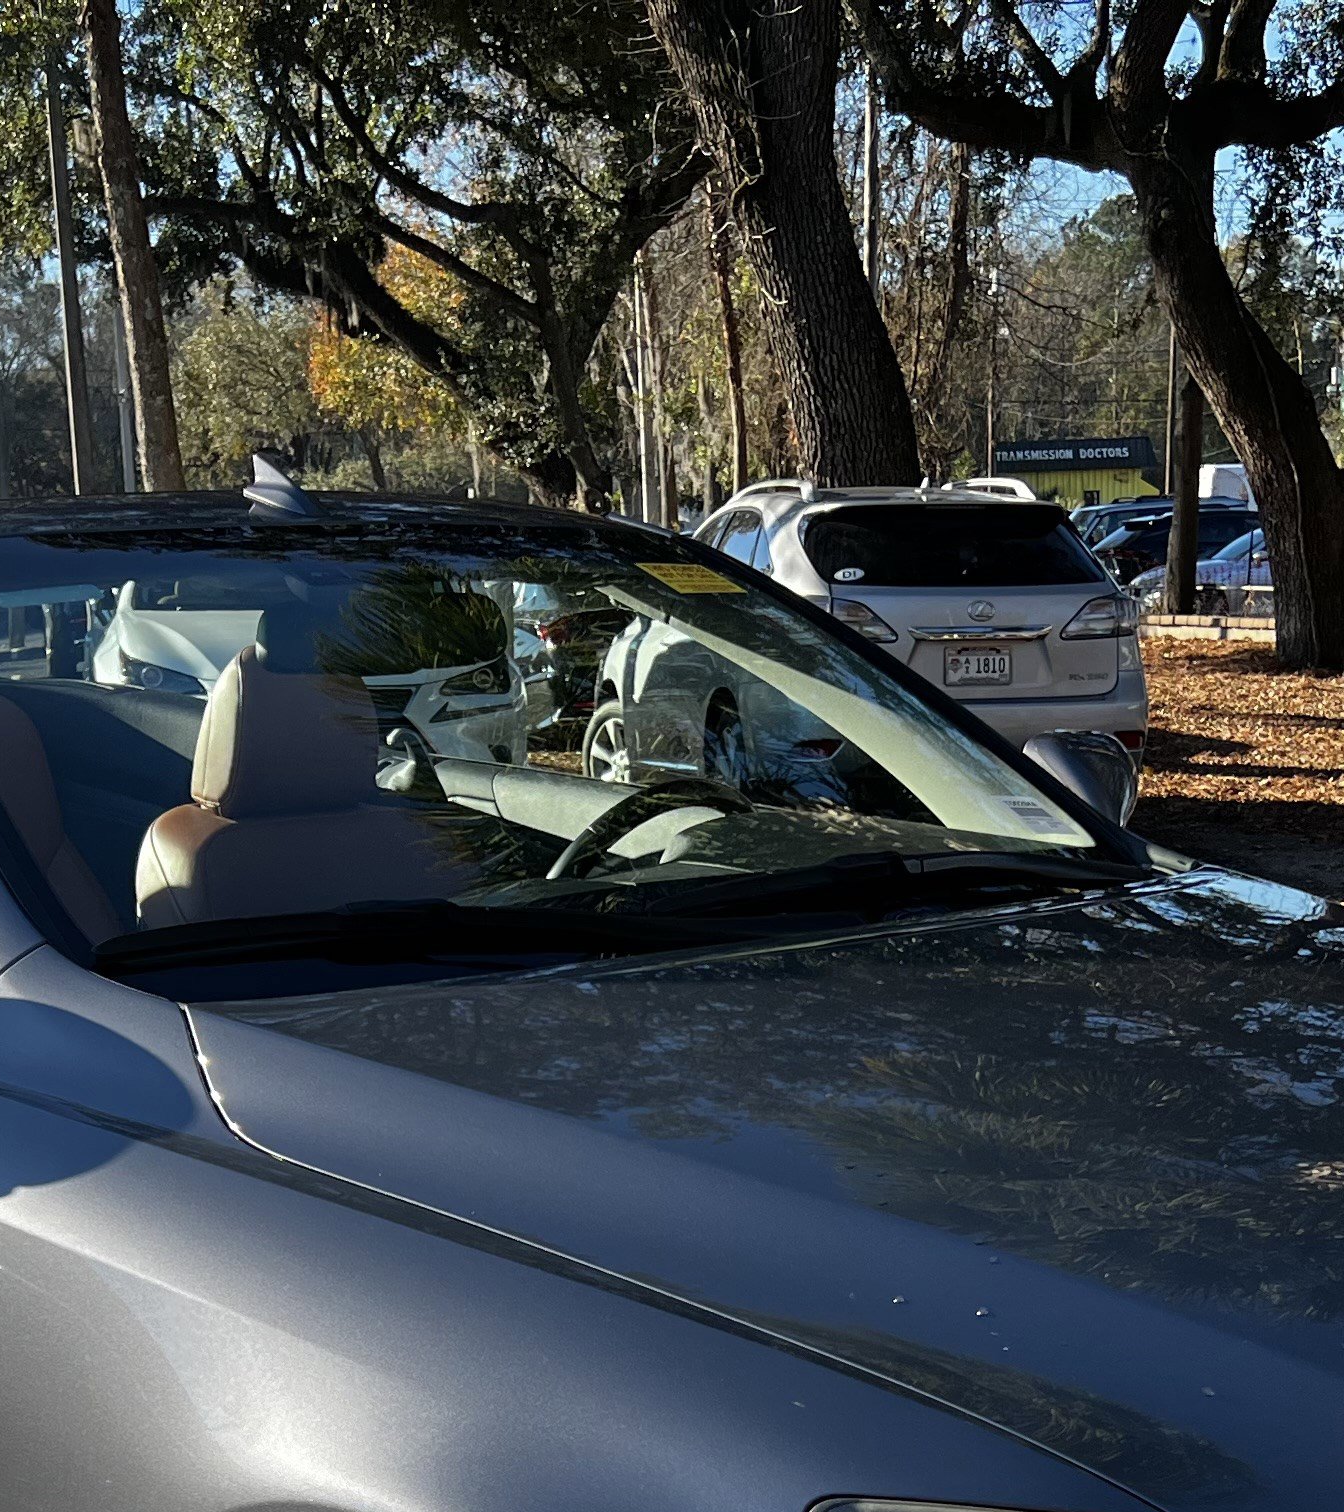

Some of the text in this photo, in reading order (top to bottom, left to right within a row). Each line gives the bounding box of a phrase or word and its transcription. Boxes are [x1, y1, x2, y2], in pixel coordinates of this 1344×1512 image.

[996, 446, 1130, 462] TRANSMISSION DOCTORS
[975, 657, 1006, 674] 1810
